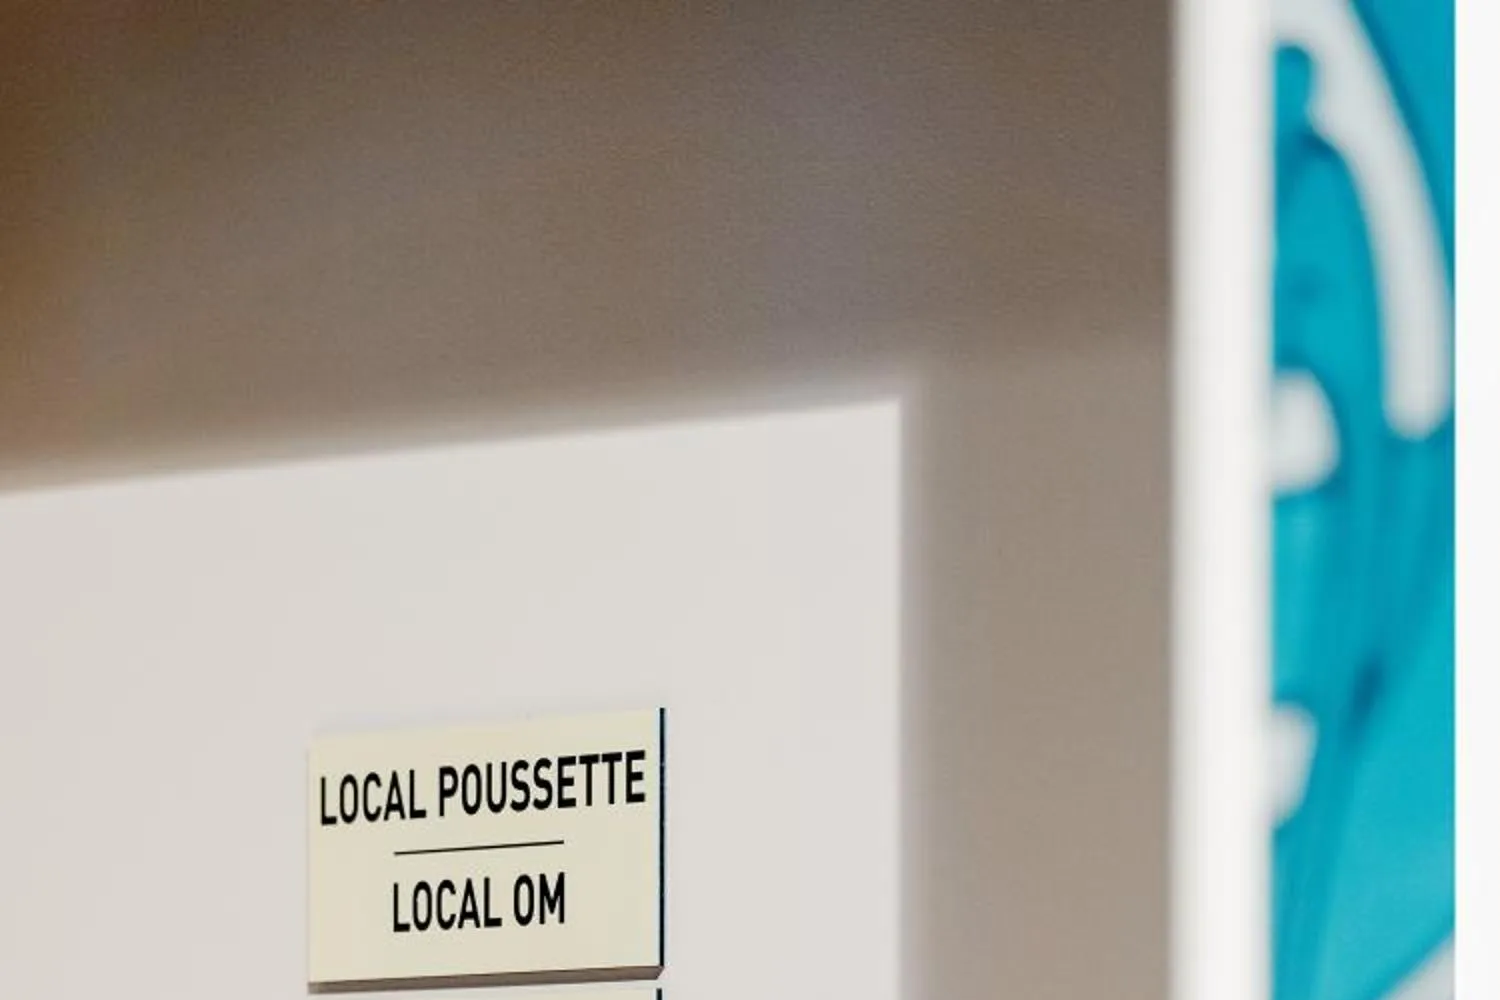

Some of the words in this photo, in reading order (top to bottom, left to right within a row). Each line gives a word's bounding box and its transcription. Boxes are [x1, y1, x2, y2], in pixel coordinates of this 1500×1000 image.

[320, 769, 427, 826] LOCAL
[438, 749, 646, 818] POUSSETTE
[393, 876, 503, 933] LOCAL
[513, 871, 565, 927] OM
